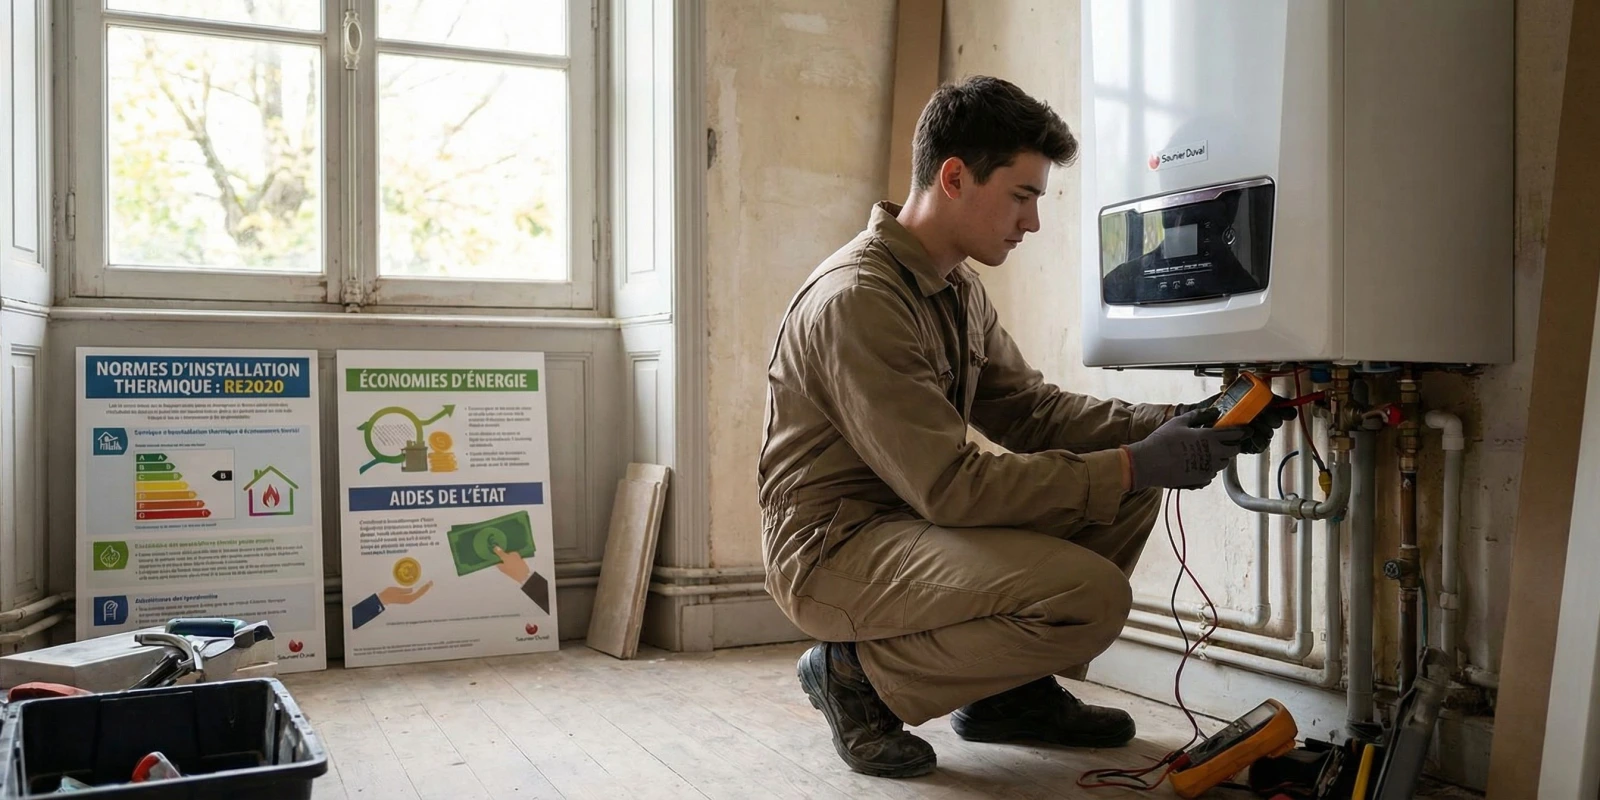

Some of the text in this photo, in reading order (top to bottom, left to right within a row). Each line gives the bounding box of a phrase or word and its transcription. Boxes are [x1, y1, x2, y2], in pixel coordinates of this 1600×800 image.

[1161, 145, 1205, 163] Saunier Duval
[96, 361, 300, 377] NORMES D'INSTALLATION
[114, 379, 212, 395] THERMIQUE
[224, 380, 284, 394] RE2020
[359, 369, 528, 388] ÉCONOMIES D'ÉNERGIE
[389, 485, 506, 507] AIDES DE L'ÉTAT
